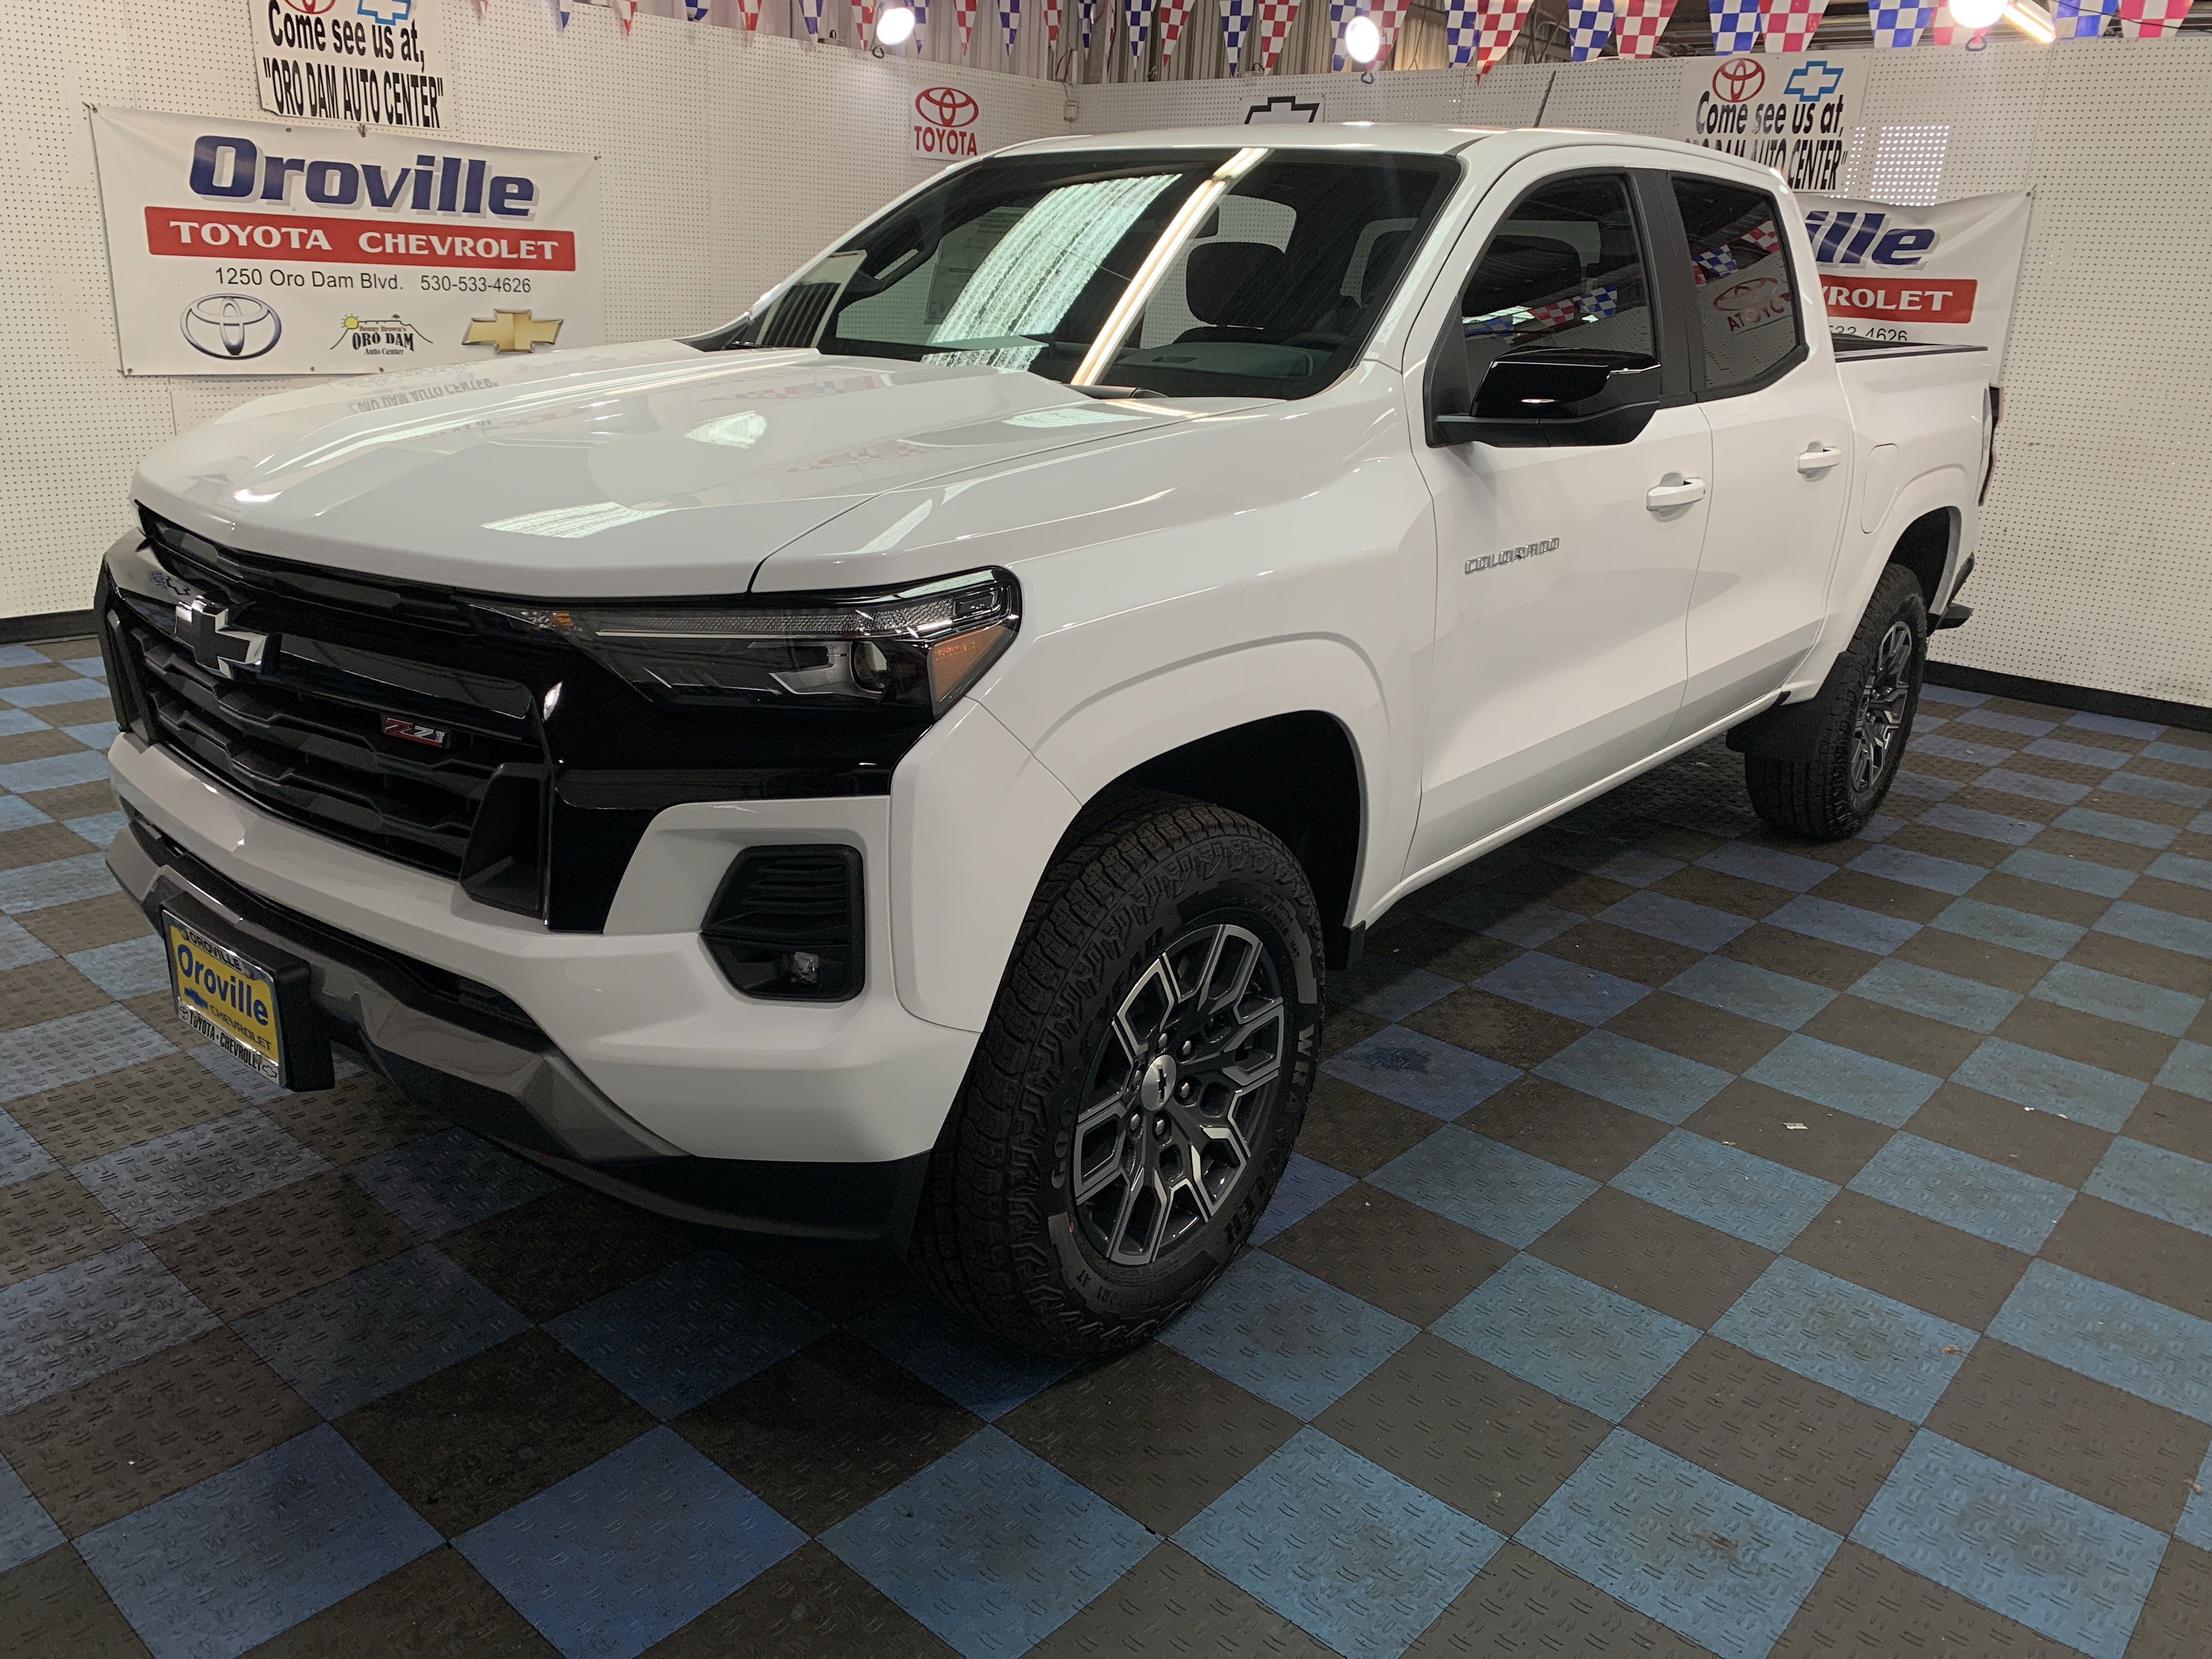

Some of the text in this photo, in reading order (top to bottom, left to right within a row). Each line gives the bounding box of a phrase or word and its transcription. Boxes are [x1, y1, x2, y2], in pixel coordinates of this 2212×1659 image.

[268, 0, 425, 73] Come see us at,
[263, 57, 443, 128] "ORO DAM AUTO CENTER"
[1696, 91, 1844, 137] Come see us at,
[914, 125, 978, 156] TOYOTA
[189, 135, 534, 217] Oroville
[170, 221, 558, 261] TOYOTA CHEVROLET
[215, 267, 531, 293] 1250 Oro Dam Blvd. 530-533-4626
[352, 332, 415, 352] ORO DAM
[1465, 537, 1560, 574] COLORADO
[383, 718, 447, 747] Z71
[189, 932, 242, 972] OROVILLE
[178, 944, 268, 1026] Oroville
[210, 1005, 272, 1051] CHEVROLET
